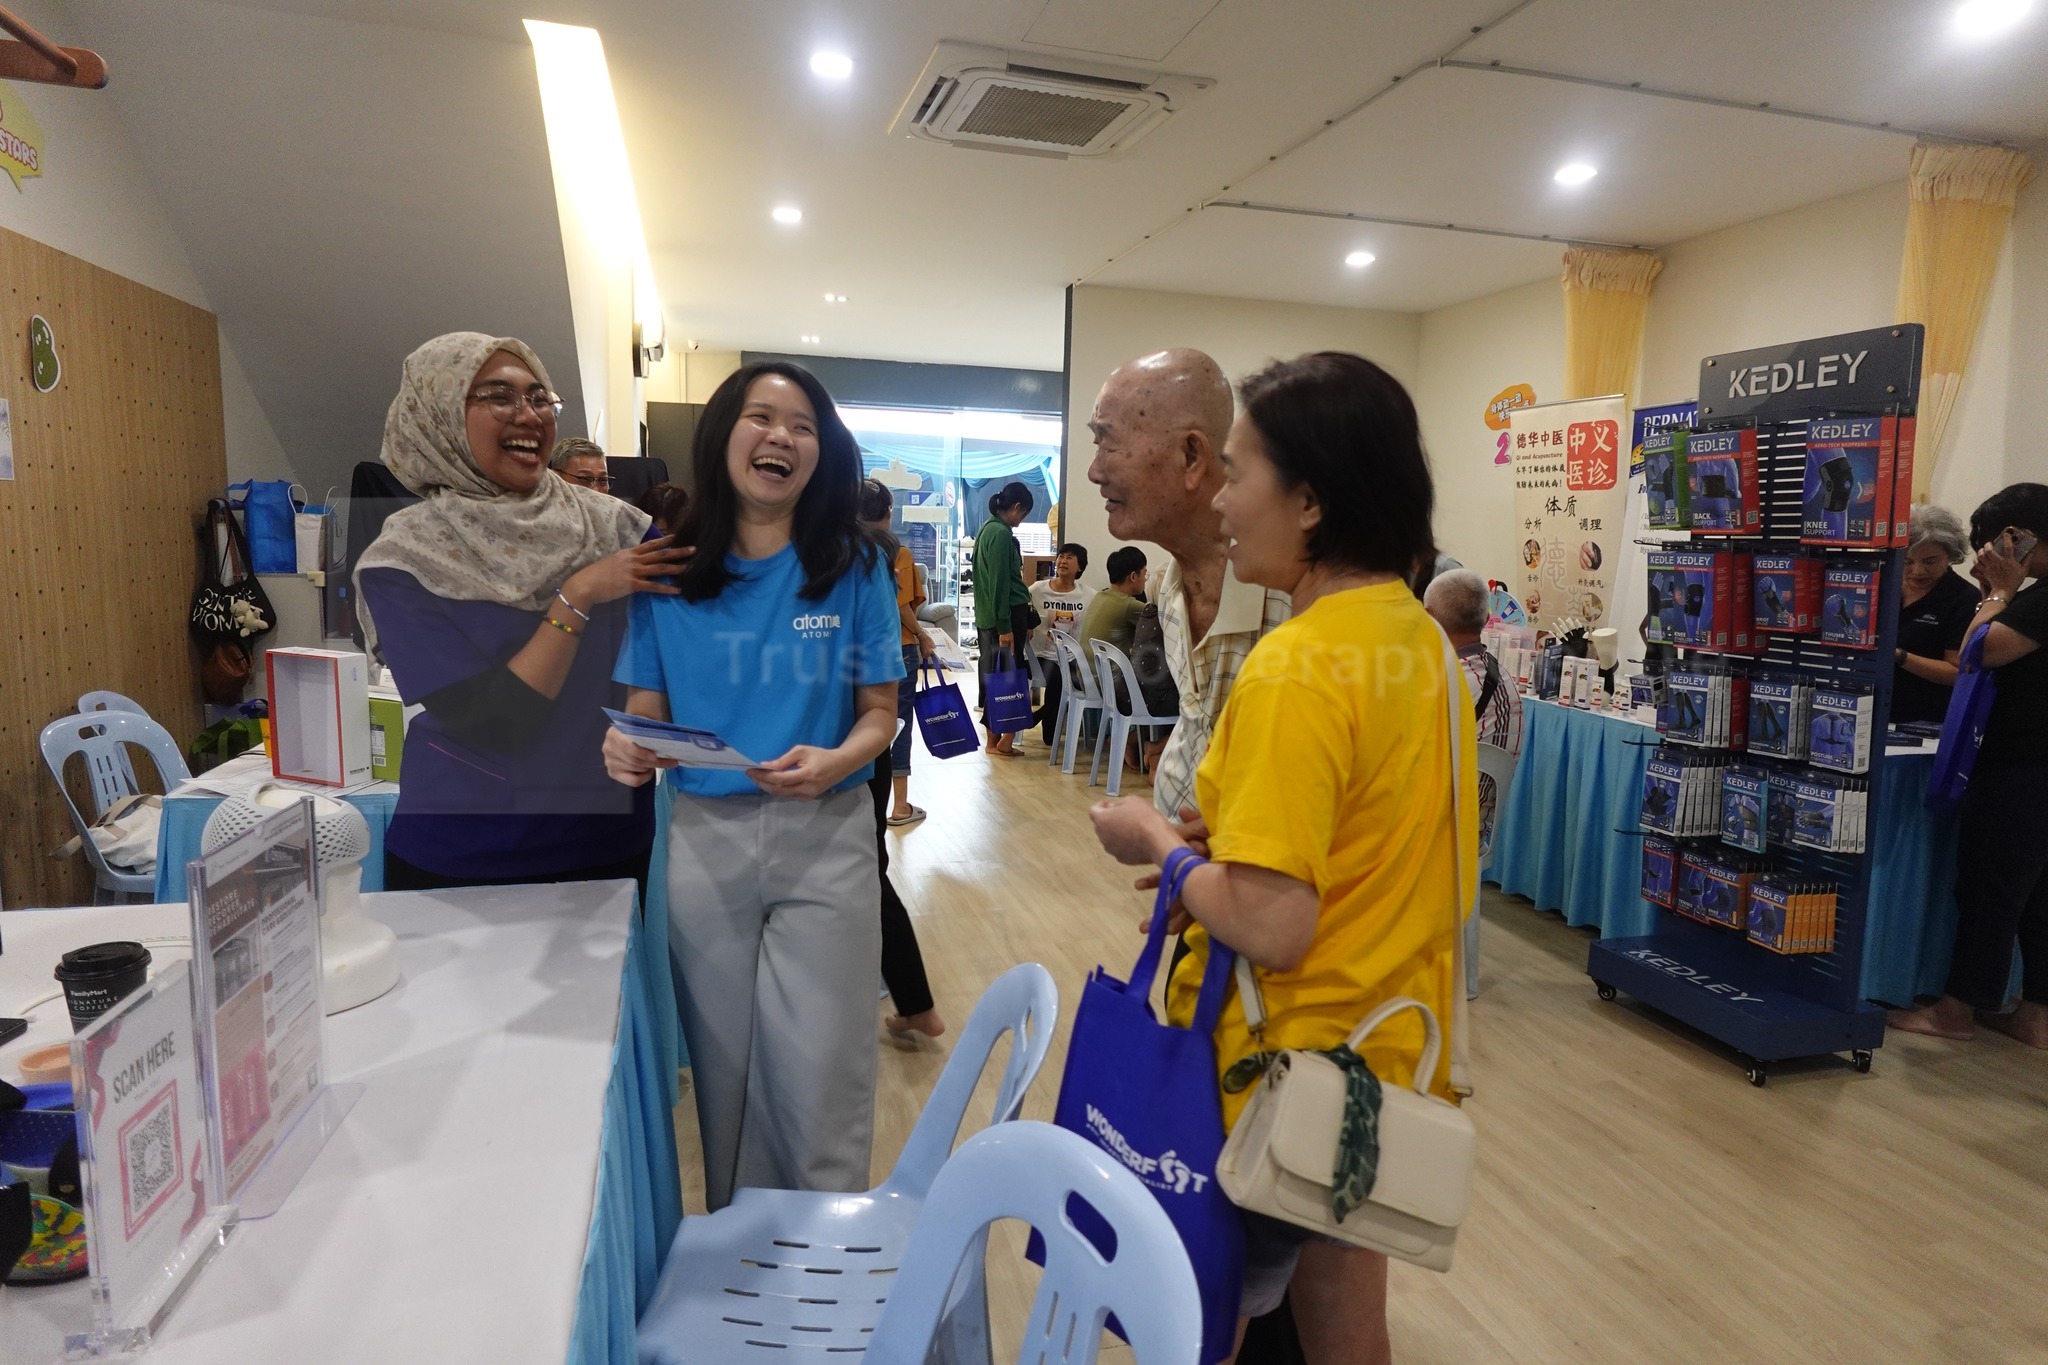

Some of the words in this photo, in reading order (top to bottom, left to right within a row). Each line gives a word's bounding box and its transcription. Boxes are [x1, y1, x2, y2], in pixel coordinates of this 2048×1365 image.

[1728, 350, 1869, 398] KEDLEY
[1811, 423, 1873, 439] KEDLEY
[1516, 430, 1564, 449] 德华中医
[1645, 436, 1671, 448] KEDLEY
[1690, 438, 1734, 453] KEDLEY
[1495, 432, 1510, 464] 2
[1545, 495, 1577, 518] 体质
[1694, 512, 1711, 520] BACK
[1806, 521, 1828, 529] KNEE
[1650, 555, 1674, 565] KEDLE
[1676, 556, 1711, 566] KEDLEY
[1756, 560, 1790, 569] KEDLEY
[1829, 572, 1868, 583] KEDLEY
[1043, 601, 1084, 611] DYNAMIC
[1672, 675, 1705, 686] KEDLEY
[1754, 684, 1787, 696] KEDLEY
[1816, 695, 1854, 708] KEDLEY
[1649, 763, 1679, 777] KEDLEY
[1726, 776, 1759, 791] KEDLEY
[1769, 775, 1797, 790] KEDLE
[1798, 785, 1833, 799] KEDLEY
[1709, 866, 1737, 881] KEDLEY
[1753, 886, 1785, 904] KEDLEY
[1622, 949, 1765, 1003] KEDLEY
[70, 989, 108, 997] FamilyMart
[113, 1056, 145, 1104] SCAN
[146, 1030, 176, 1076] HERE
